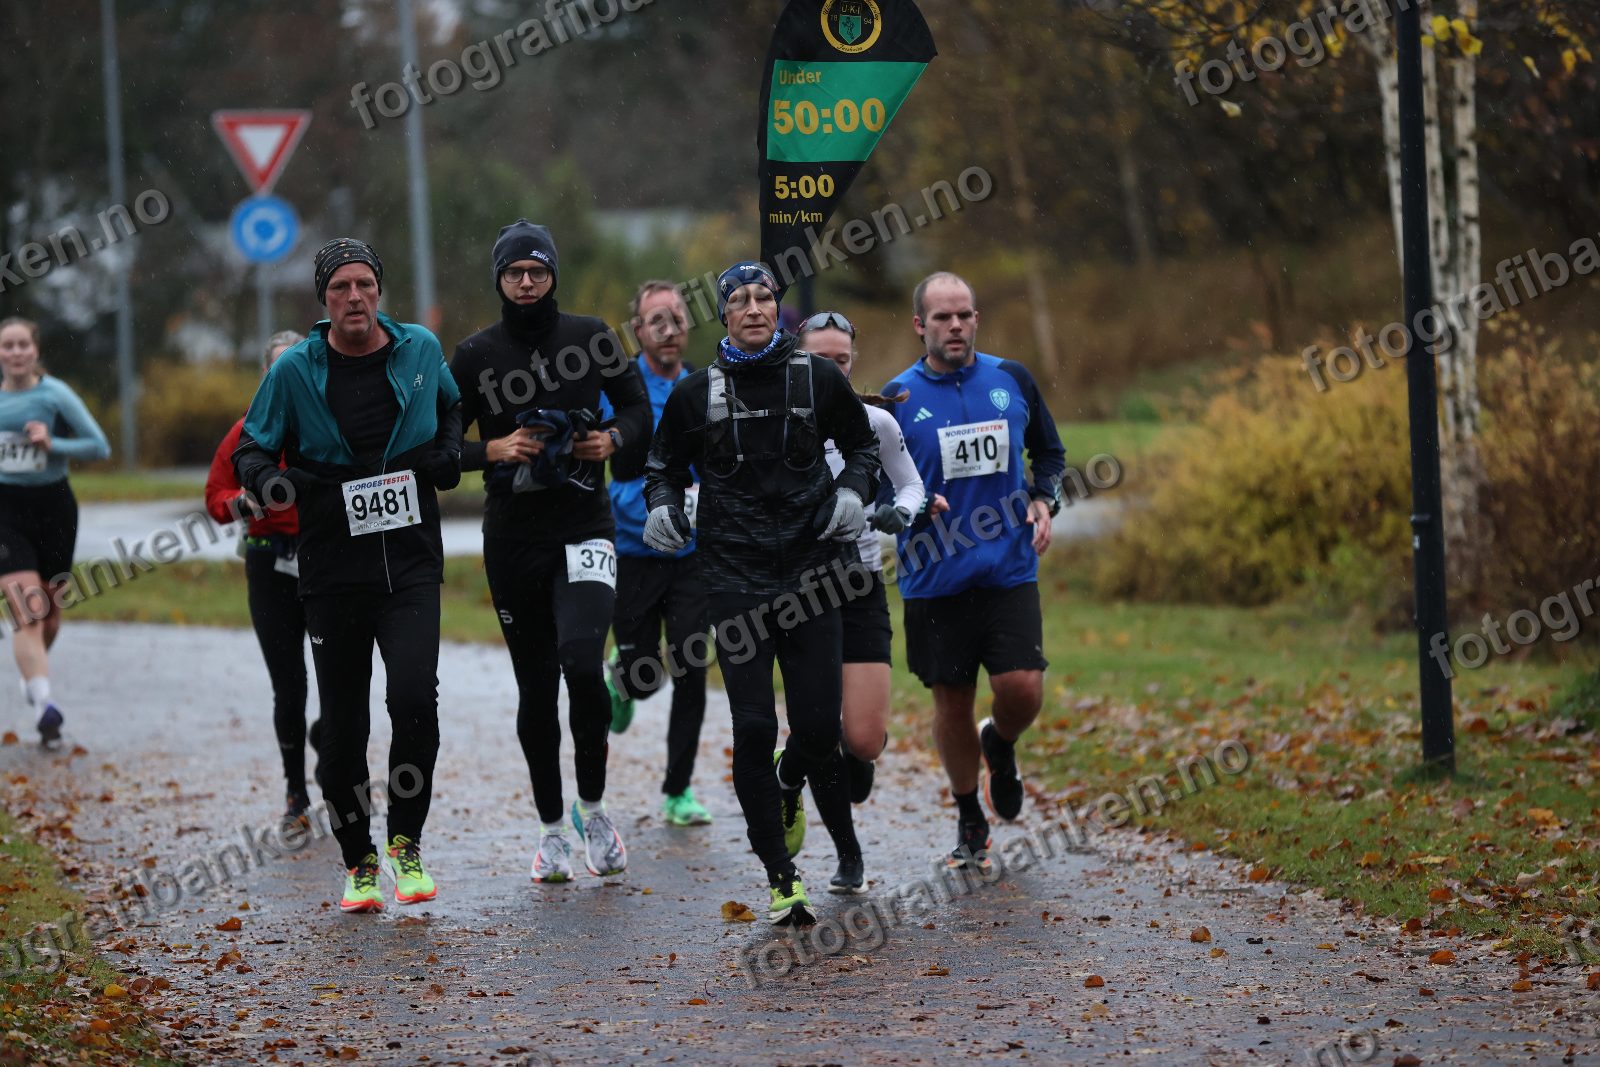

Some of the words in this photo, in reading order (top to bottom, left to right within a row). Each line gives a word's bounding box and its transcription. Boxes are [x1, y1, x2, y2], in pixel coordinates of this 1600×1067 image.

[779, 69, 822, 85] Under
[773, 97, 886, 135] 50:00
[774, 174, 835, 199] 5:00
[769, 210, 823, 226] min/km
[955, 434, 998, 464] 410
[351, 485, 410, 521] 9481
[580, 548, 616, 578] 370
